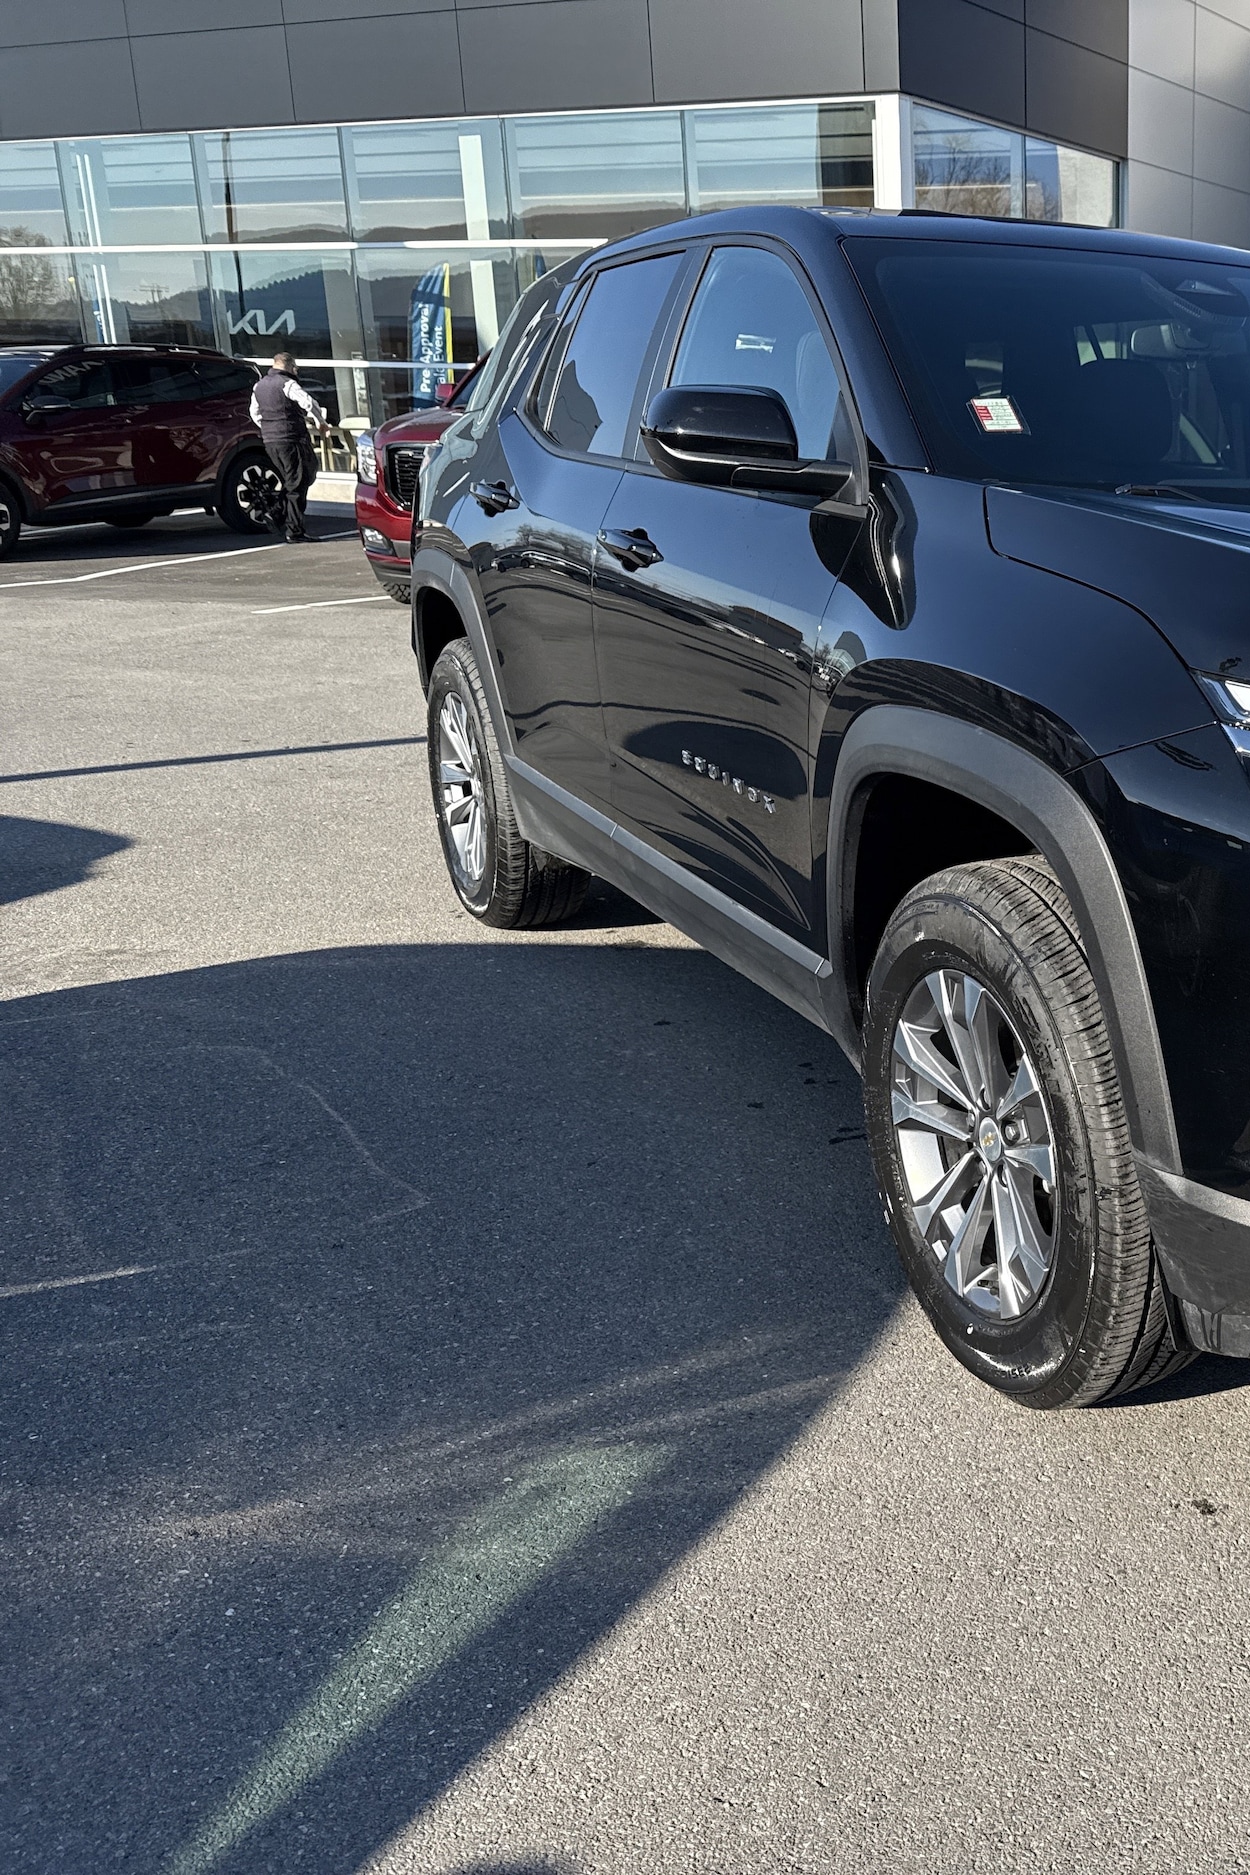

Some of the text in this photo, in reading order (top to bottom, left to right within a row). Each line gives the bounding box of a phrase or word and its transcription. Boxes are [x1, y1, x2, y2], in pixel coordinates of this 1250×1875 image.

[226, 309, 296, 336] KIA
[433, 325, 444, 362] Event
[681, 749, 777, 814] EQUINOX
